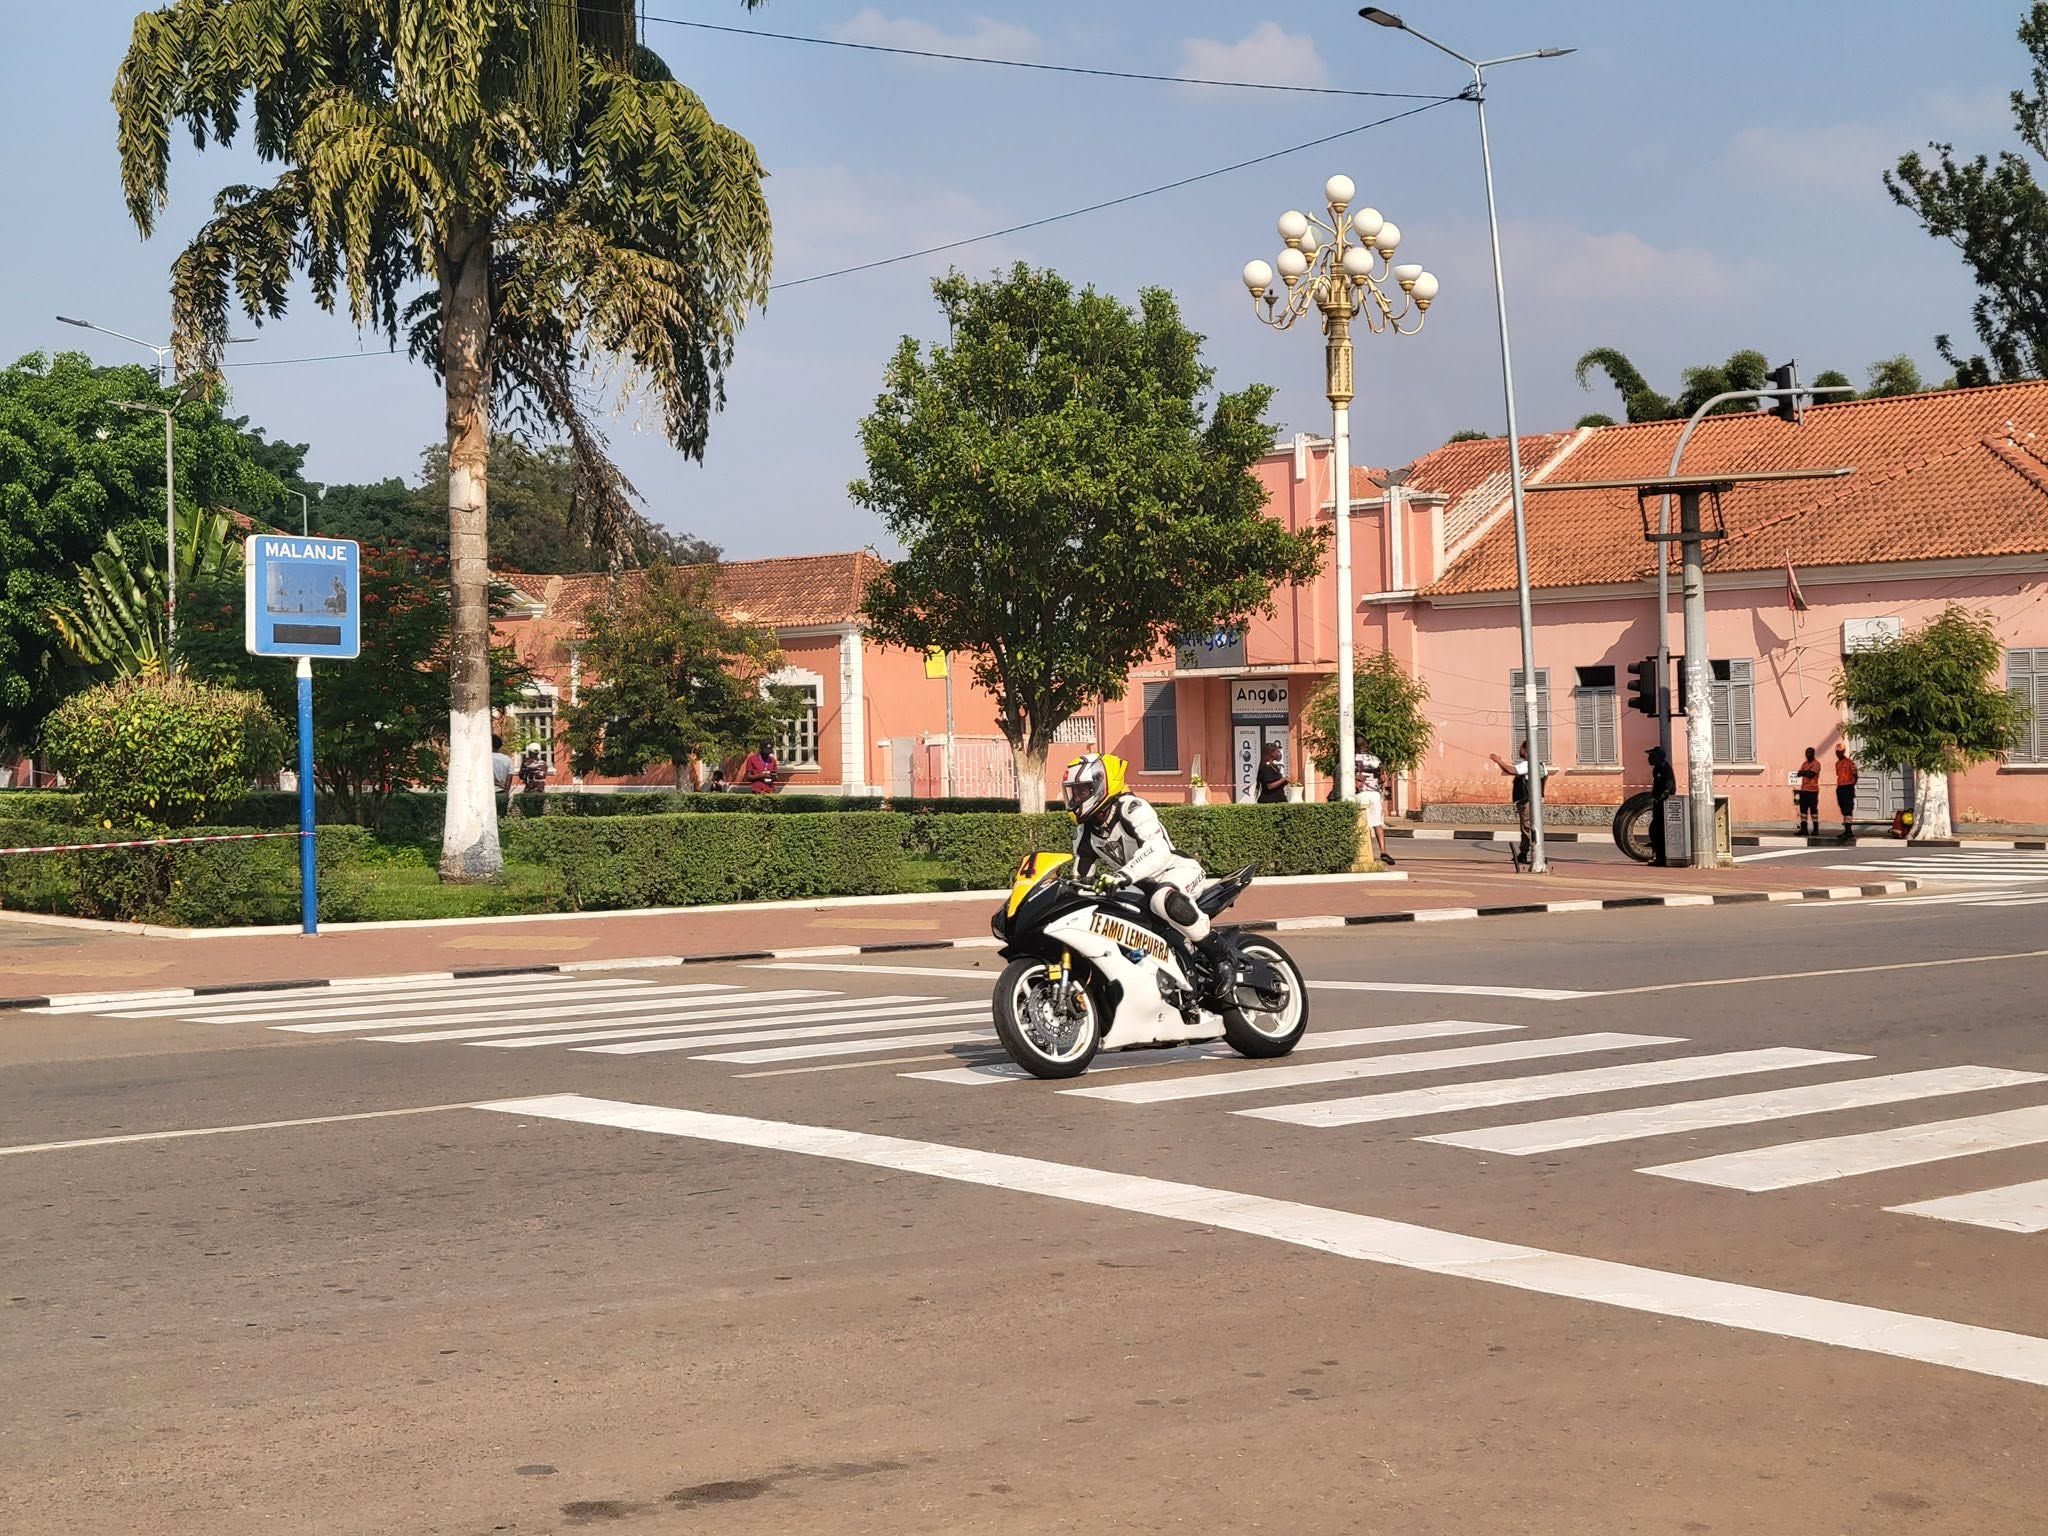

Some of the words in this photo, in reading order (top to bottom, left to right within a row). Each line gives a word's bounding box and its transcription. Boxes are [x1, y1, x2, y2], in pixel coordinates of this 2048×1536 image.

[265, 541, 348, 561] MALANJE
[1236, 687, 1288, 705] Angop
[1019, 852, 1037, 878] 4
[1089, 912, 1103, 933] TE
[1101, 918, 1125, 942] AMO
[1124, 926, 1170, 963] LEMPURRA
